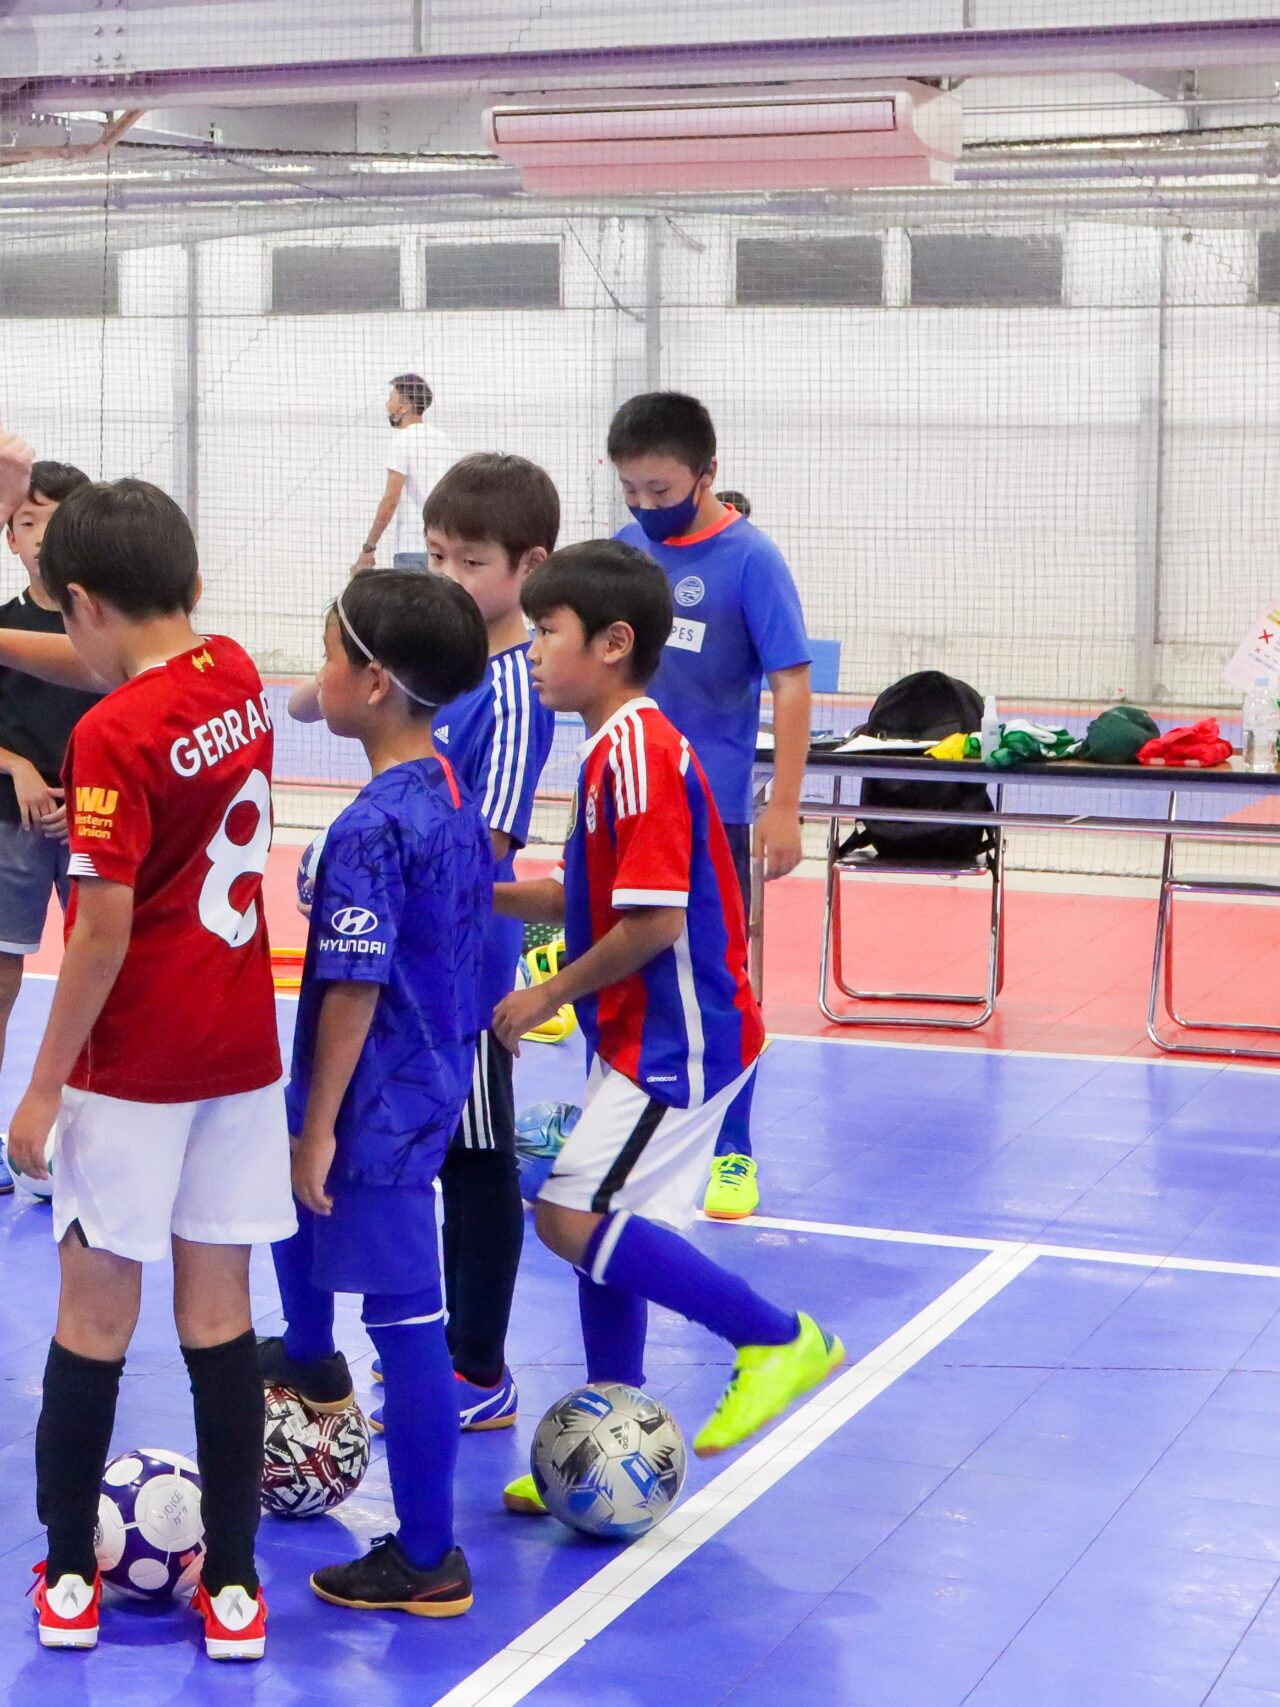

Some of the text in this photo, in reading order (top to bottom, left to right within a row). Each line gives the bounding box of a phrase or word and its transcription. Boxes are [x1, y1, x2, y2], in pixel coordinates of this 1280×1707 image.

[75, 786, 119, 815] WU
[198, 768, 271, 948] 8
[319, 939, 387, 956] HYUNDAI
